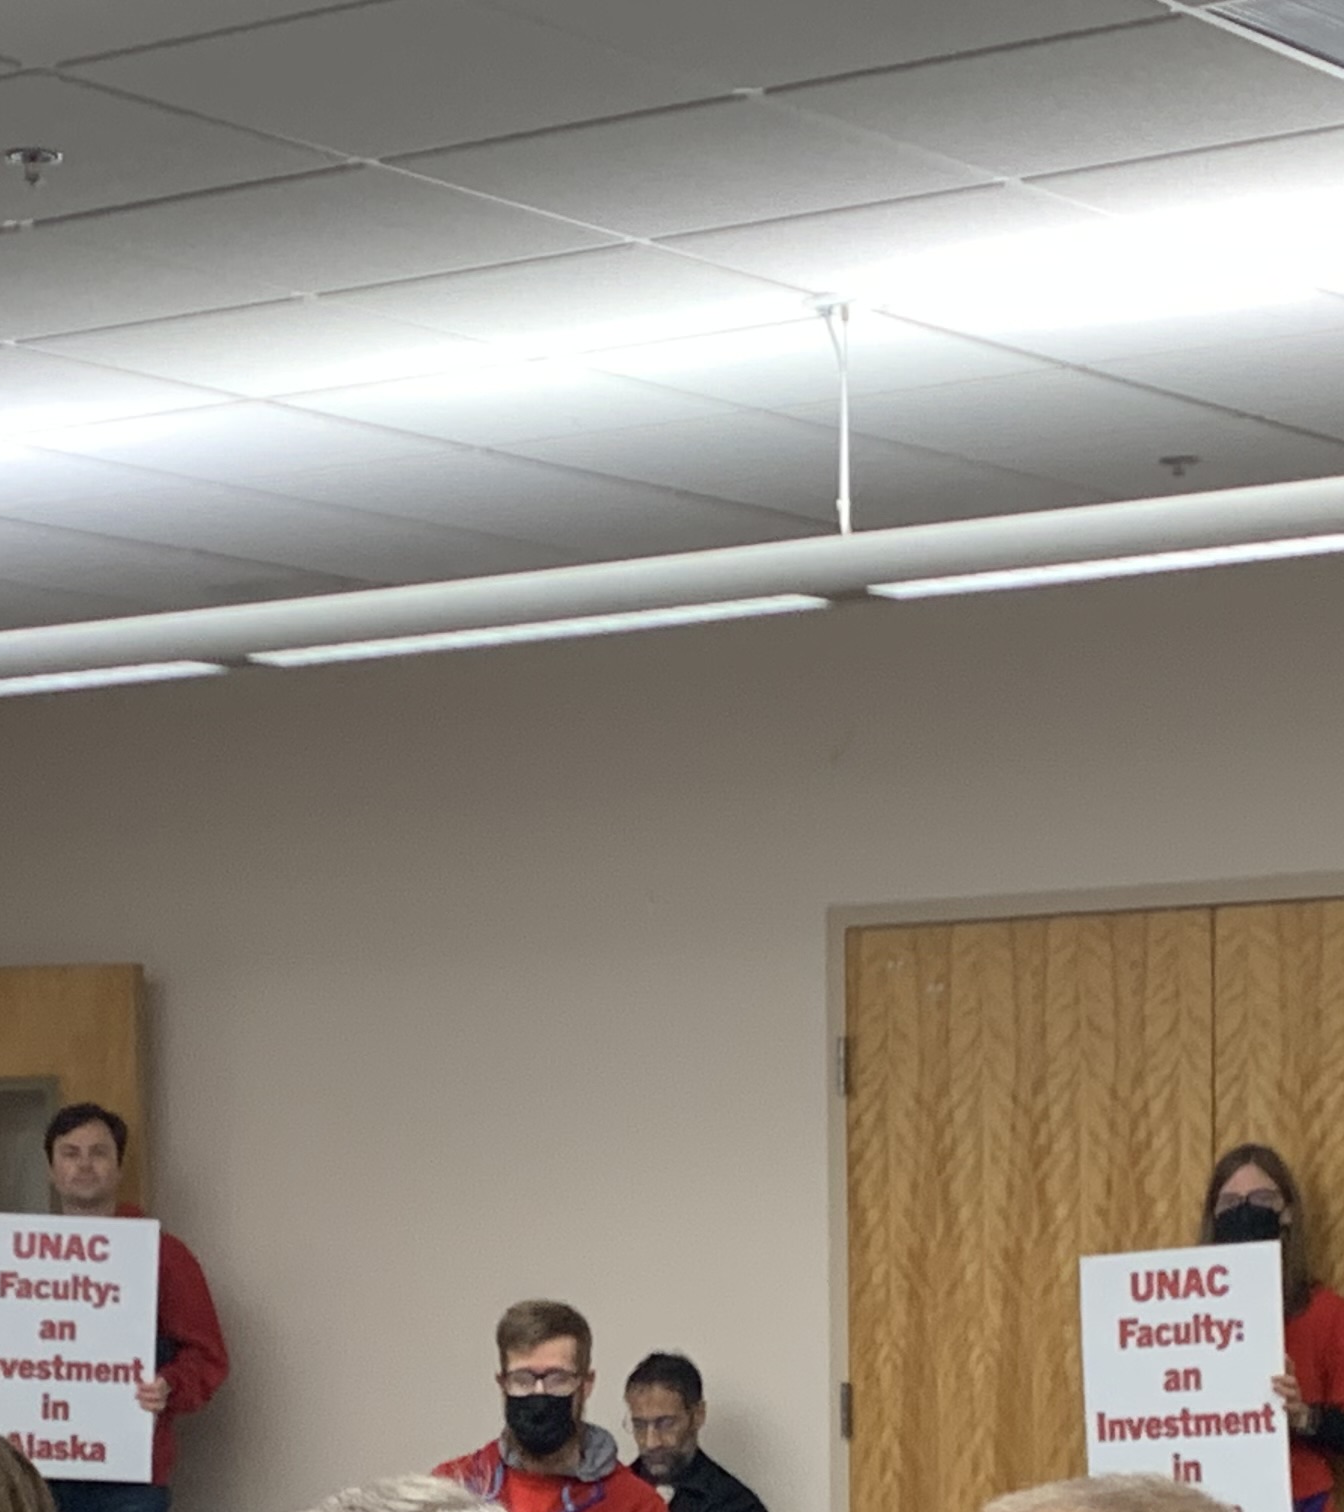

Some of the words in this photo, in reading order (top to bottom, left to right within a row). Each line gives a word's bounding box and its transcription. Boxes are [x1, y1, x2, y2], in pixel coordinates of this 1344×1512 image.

[13, 1232, 110, 1262] UNAC
[1130, 1264, 1229, 1302] UNAC
[39, 1319, 76, 1341] an
[1118, 1313, 1244, 1350] Faculty:
[1163, 1366, 1202, 1392] an
[41, 1393, 69, 1421] in
[1097, 1402, 1276, 1442] Investment
[8, 1432, 106, 1463] Alaska
[1173, 1452, 1202, 1483] in
